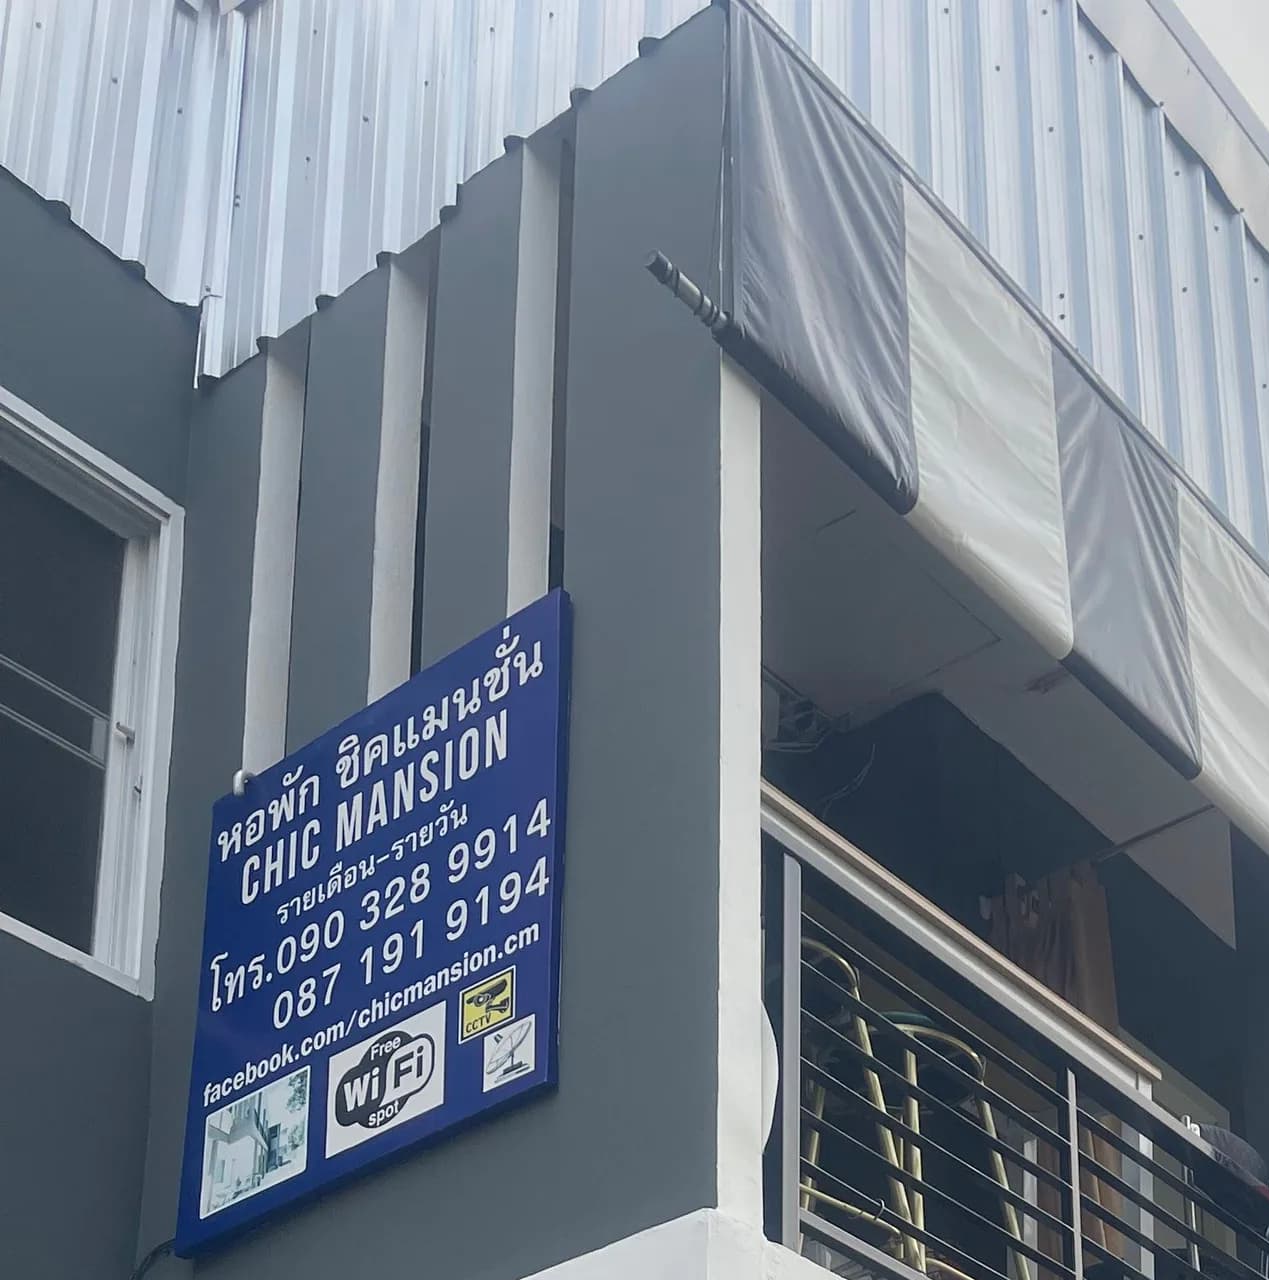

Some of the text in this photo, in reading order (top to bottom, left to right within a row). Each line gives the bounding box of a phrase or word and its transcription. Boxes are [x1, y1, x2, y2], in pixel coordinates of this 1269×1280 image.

[217, 625, 543, 862] หอพัก ชิคแมนชั่น
[241, 708, 508, 905] CHIC MANSION
[277, 799, 468, 924] รายเดือน-รายวัน
[359, 862, 431, 931] 328
[448, 798, 551, 884] 9914
[273, 856, 550, 1030] 087 191 9194
[203, 922, 540, 1107] facebook.com/chicmansion.cm
[371, 1036, 402, 1061] Free
[465, 1011, 493, 1034] CCTV
[368, 1099, 401, 1128] spot
